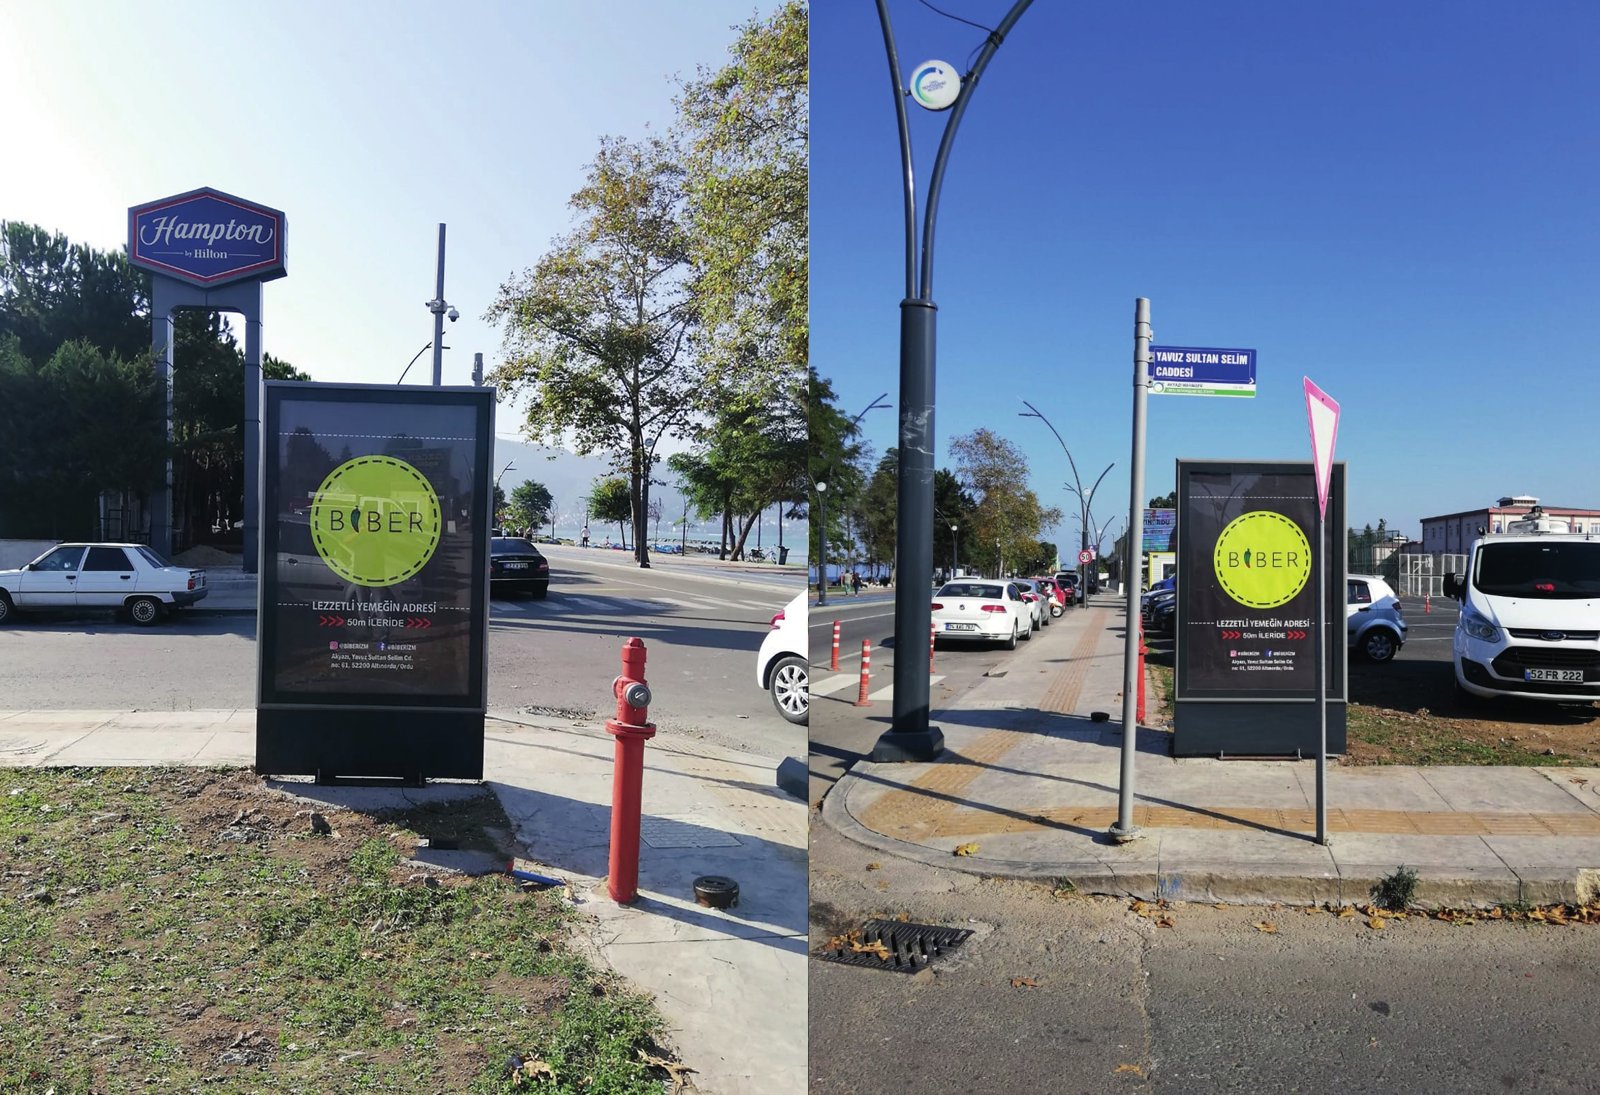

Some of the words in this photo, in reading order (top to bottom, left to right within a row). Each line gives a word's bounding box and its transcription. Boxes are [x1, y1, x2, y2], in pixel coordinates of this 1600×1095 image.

[140, 215, 273, 246] Hampton
[184, 250, 193, 258] by
[194, 249, 228, 259] Hilton
[1156, 352, 1184, 362] YAVUZ
[1186, 353, 1218, 364] SULTAN
[1221, 353, 1248, 365] SELİM
[1156, 366, 1193, 378] CADDESİ
[1081, 553, 1089, 561] 50
[312, 599, 355, 611] LEZZETLİ
[356, 600, 400, 612] YEMEĞİN
[402, 602, 437, 613] ADRESİ
[347, 618, 366, 627] 50m
[368, 617, 405, 628] İLERİDE
[1216, 618, 1249, 628] LEZZETLİ
[1249, 618, 1282, 628] YEMEĞİN
[1284, 618, 1310, 628] ADRESİ
[1258, 631, 1286, 639] İLERİDE
[1531, 670, 1543, 679] 52
[1545, 670, 1559, 680] FR
[1562, 671, 1582, 681] 222
